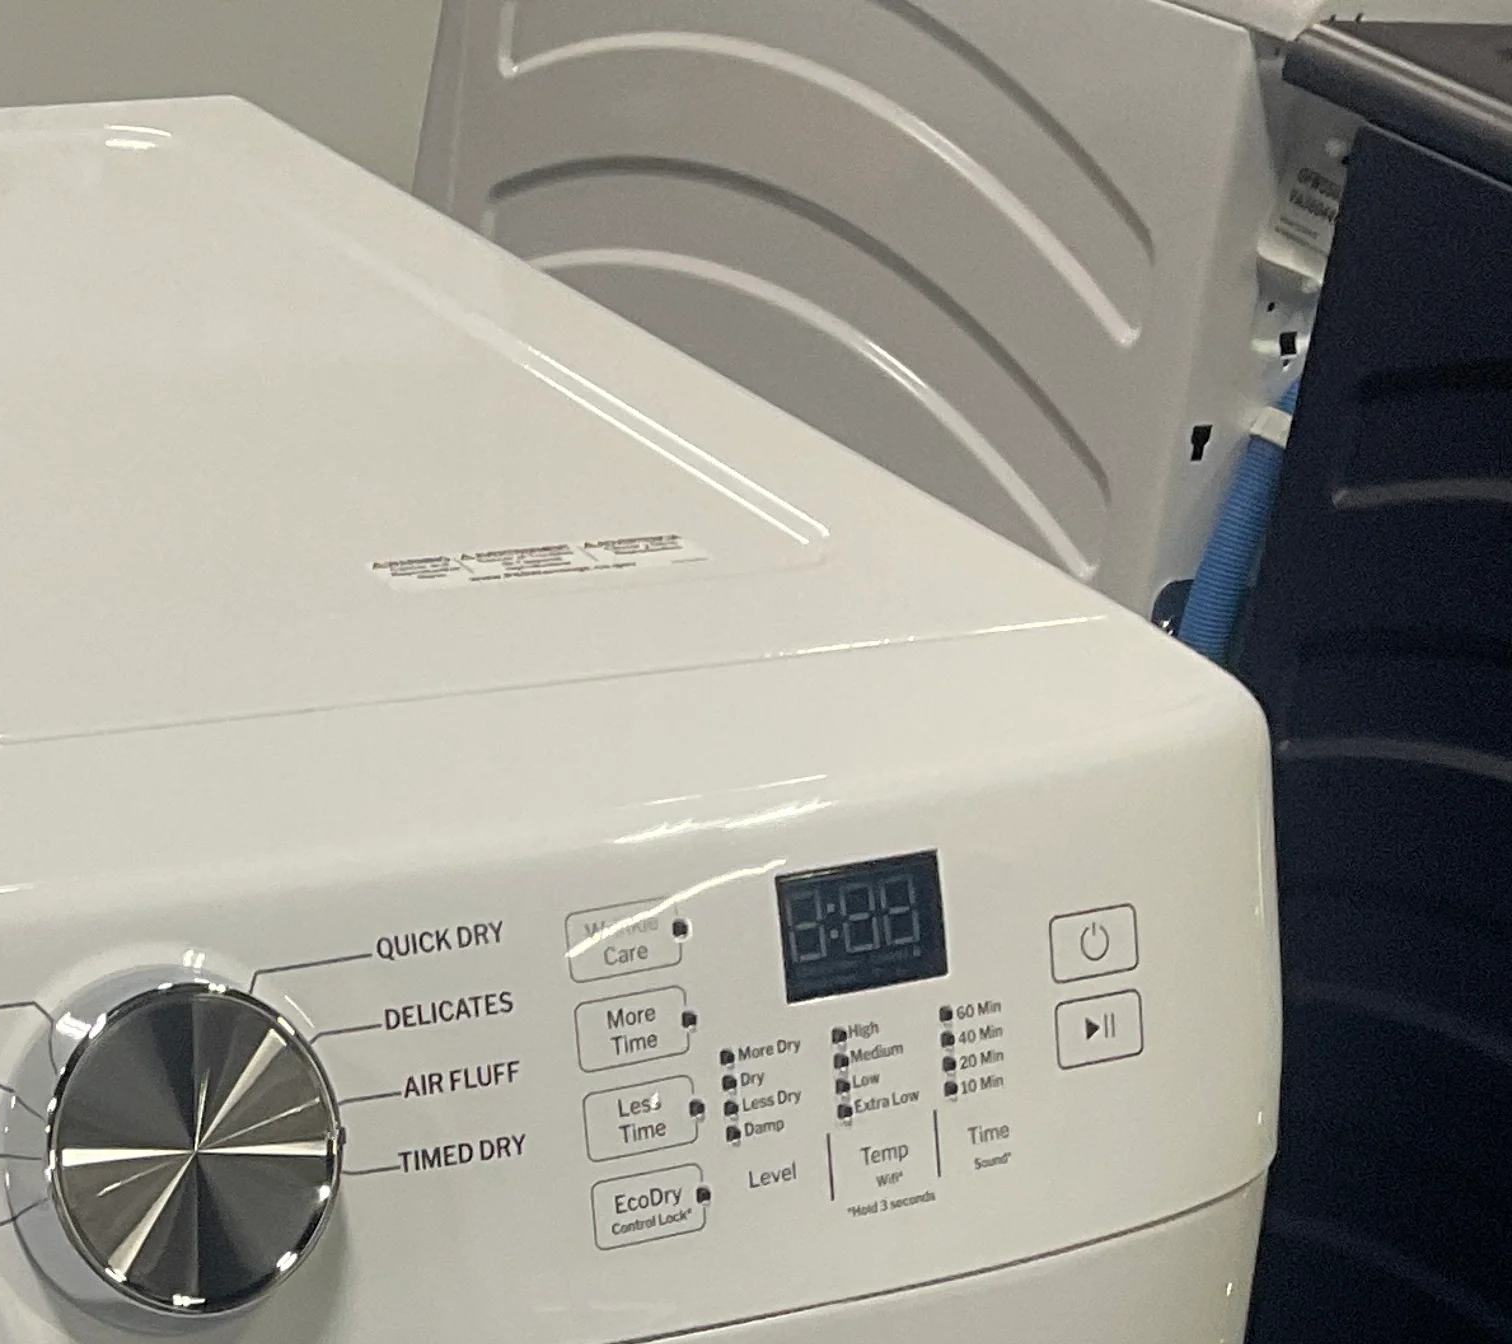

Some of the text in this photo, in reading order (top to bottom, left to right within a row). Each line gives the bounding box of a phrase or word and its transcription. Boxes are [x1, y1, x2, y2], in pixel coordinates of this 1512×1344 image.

[376, 921, 503, 961] QUICK DRY
[603, 945, 648, 966] Care
[384, 991, 514, 1031] DELICATES
[607, 1007, 656, 1030] More
[956, 1000, 1002, 1020] 60 Min
[848, 1021, 880, 1039] High
[958, 1025, 1004, 1044] 40 Min
[610, 1033, 658, 1056] Time
[738, 1039, 801, 1061] More Dry
[850, 1043, 904, 1063] Medium
[959, 1050, 1005, 1070] 20 Min
[404, 1060, 521, 1099] AIR FLUFF
[740, 1072, 765, 1087] Dry
[852, 1073, 880, 1089] Low
[961, 1075, 1005, 1095] 10 Min
[617, 1096, 662, 1118] Less
[742, 1090, 802, 1112] Less Dry
[854, 1090, 920, 1114] Extra Low
[618, 1121, 667, 1144] Time
[744, 1118, 785, 1137] Damp
[967, 1124, 1010, 1145] Time
[398, 1133, 527, 1173] TIMED DRY
[860, 1143, 909, 1166] Temp
[748, 1161, 798, 1189] Level
[614, 1187, 682, 1214] EcoDry
[879, 1200, 889, 1212] 3
[611, 1215, 656, 1236] Control
